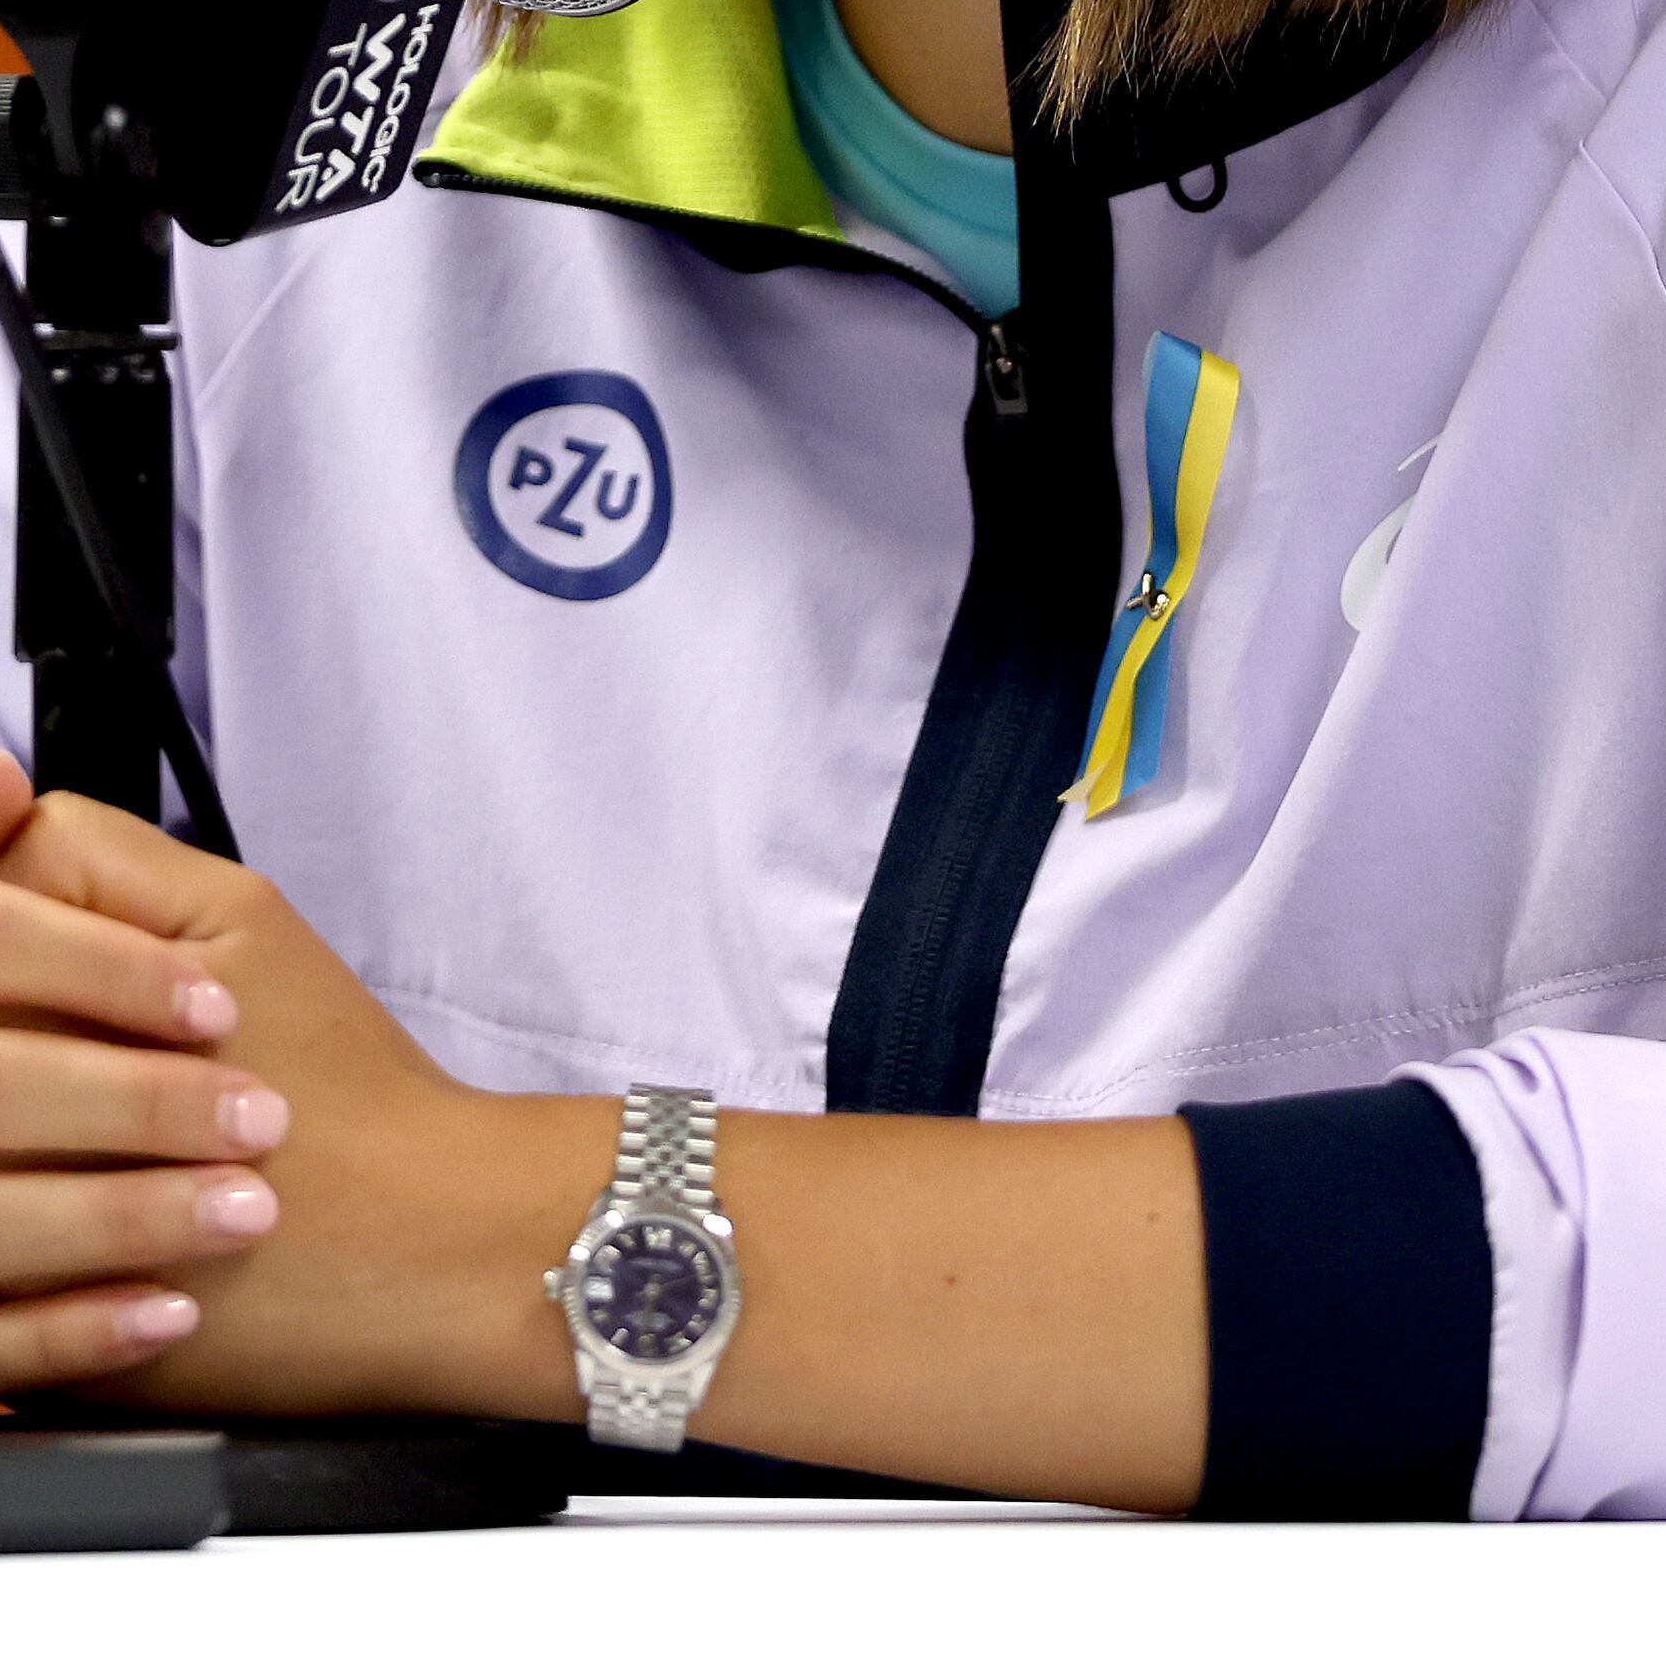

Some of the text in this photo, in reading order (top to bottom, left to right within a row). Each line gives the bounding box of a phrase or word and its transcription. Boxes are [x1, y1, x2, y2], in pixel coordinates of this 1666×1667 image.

[274, 22, 369, 214] TOUR
[315, 12, 407, 202] WTA
[361, 3, 441, 194] HOLOGIC
[509, 436, 640, 540] PZU
